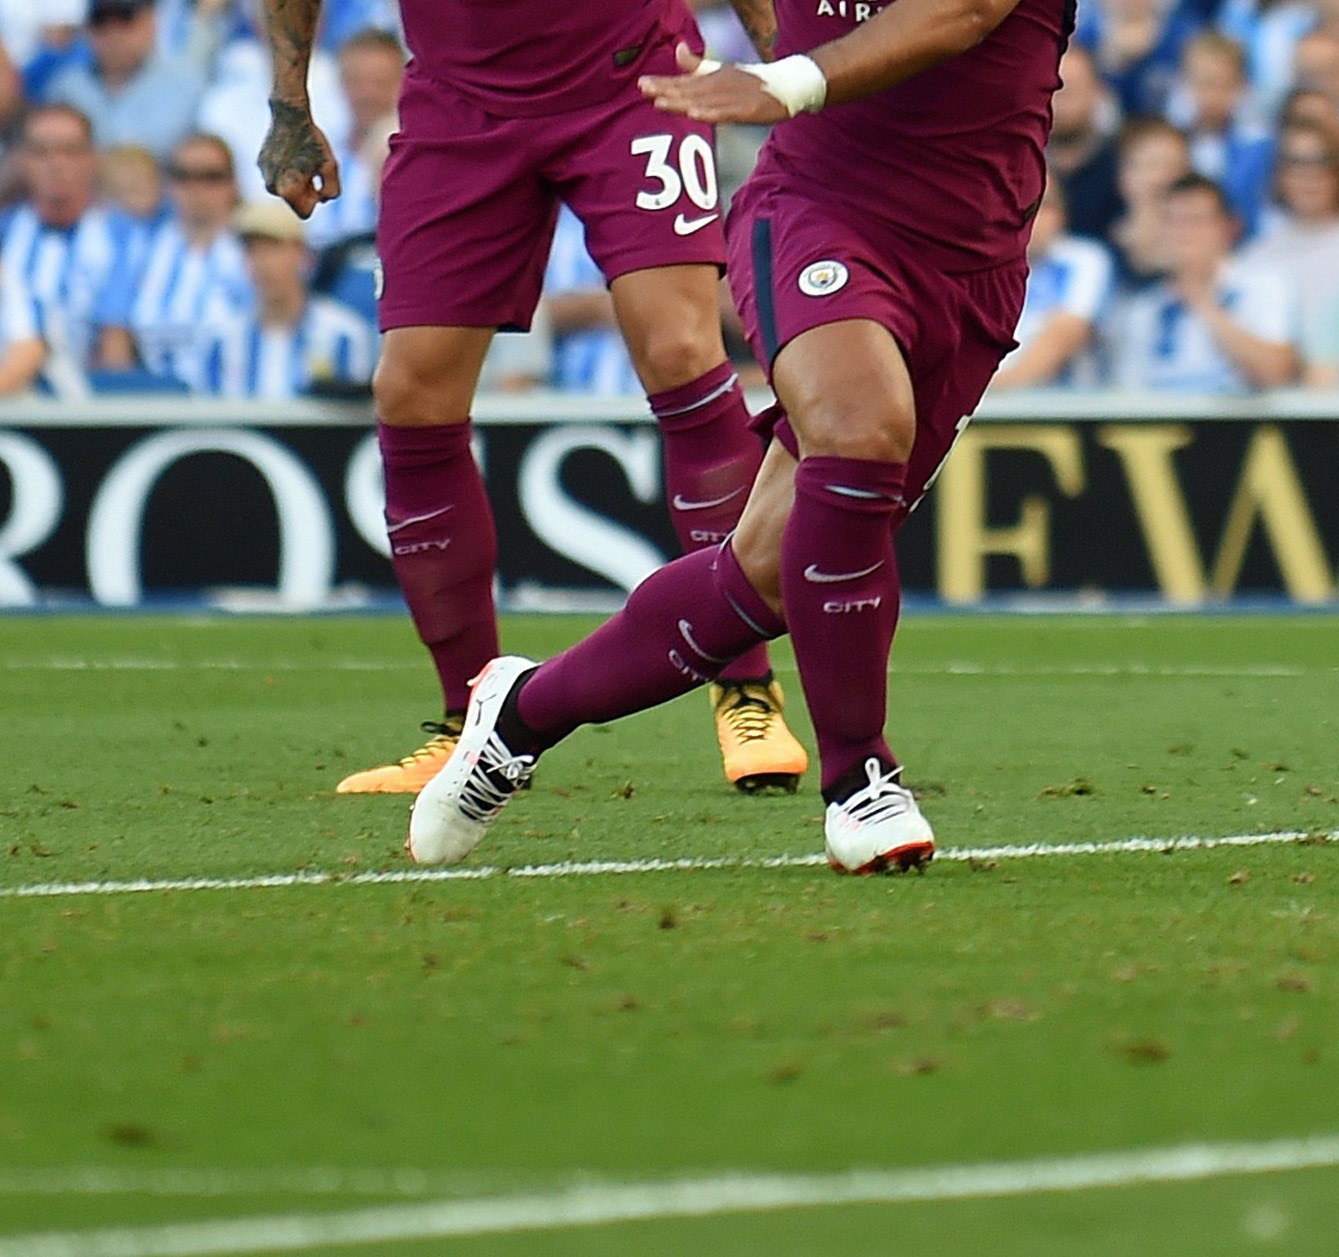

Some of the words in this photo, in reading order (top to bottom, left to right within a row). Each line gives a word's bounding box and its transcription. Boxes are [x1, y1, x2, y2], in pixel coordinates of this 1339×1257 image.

[631, 134, 718, 211] 30
[690, 529, 727, 542] CIT
[394, 538, 451, 555] CITY
[822, 596, 882, 614] CITY
